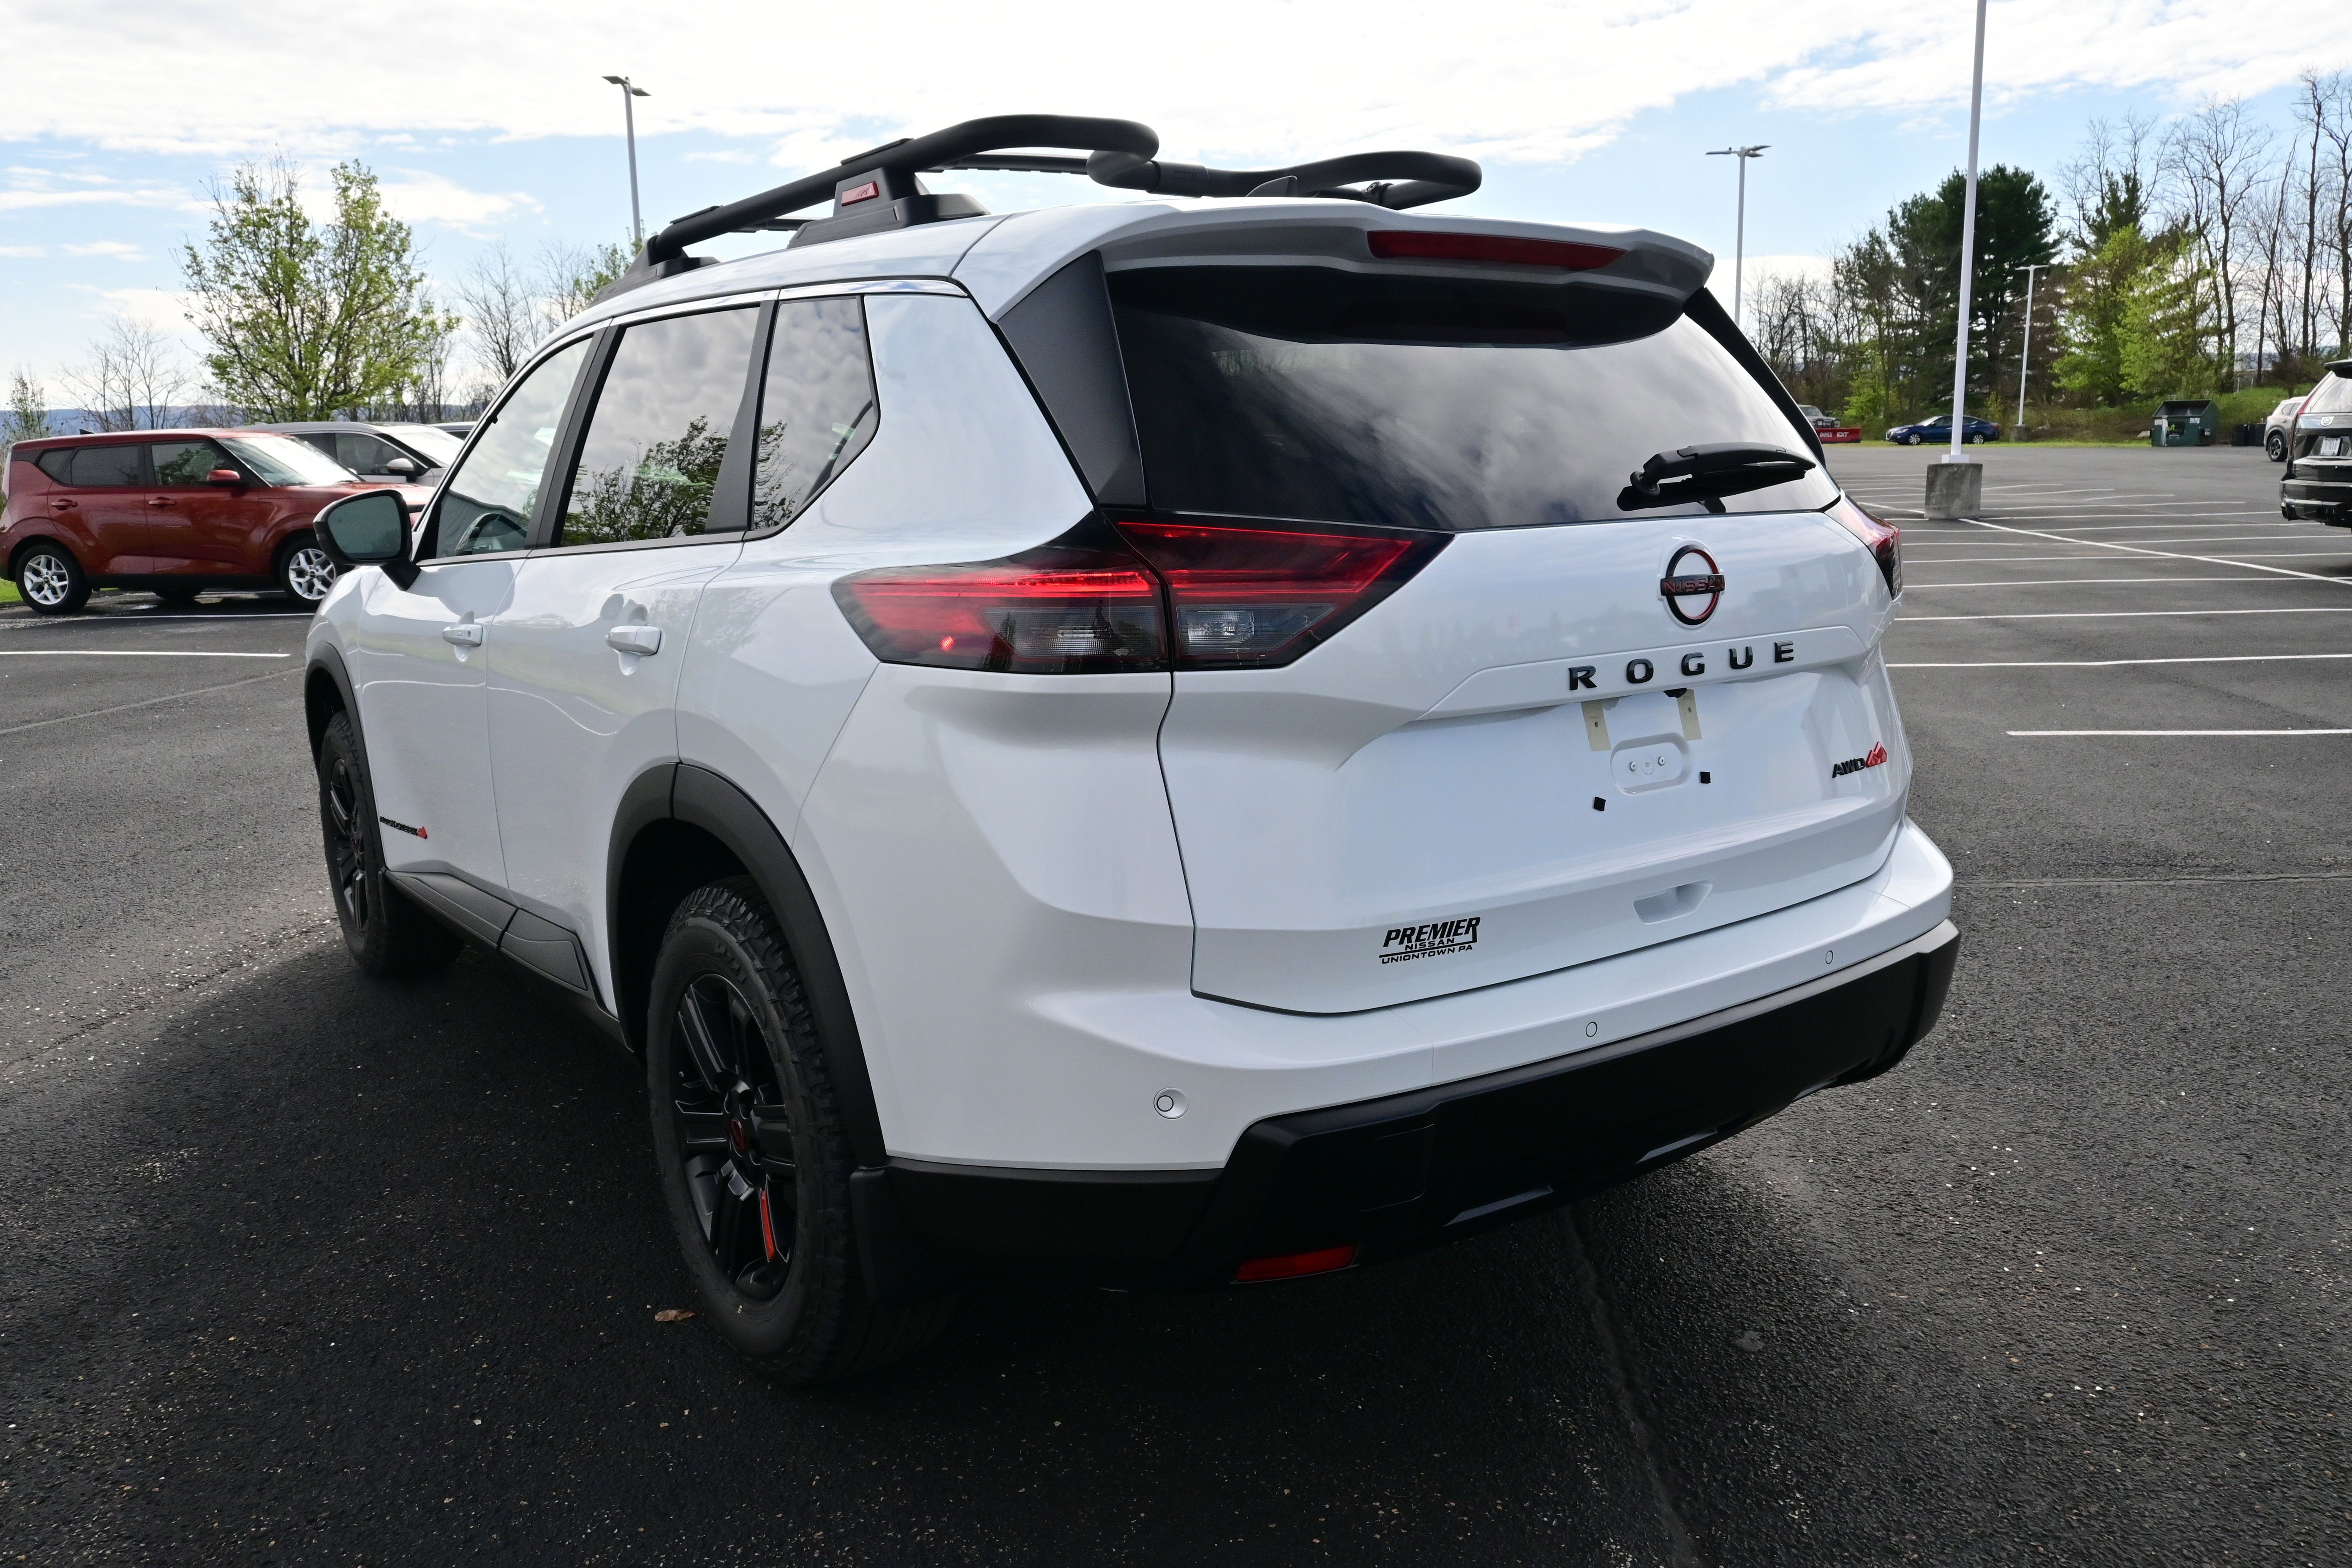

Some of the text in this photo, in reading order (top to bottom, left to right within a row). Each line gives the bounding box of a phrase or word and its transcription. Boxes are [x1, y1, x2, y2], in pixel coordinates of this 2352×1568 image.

[1664, 577, 1725, 593] NISSAN
[1568, 640, 1794, 691] ROGUE
[1832, 757, 1866, 778] AWD
[1383, 917, 1481, 947] PREMIER
[1405, 937, 1455, 951] NISSAN
[1382, 945, 1473, 964] UNIONTOWN PA
